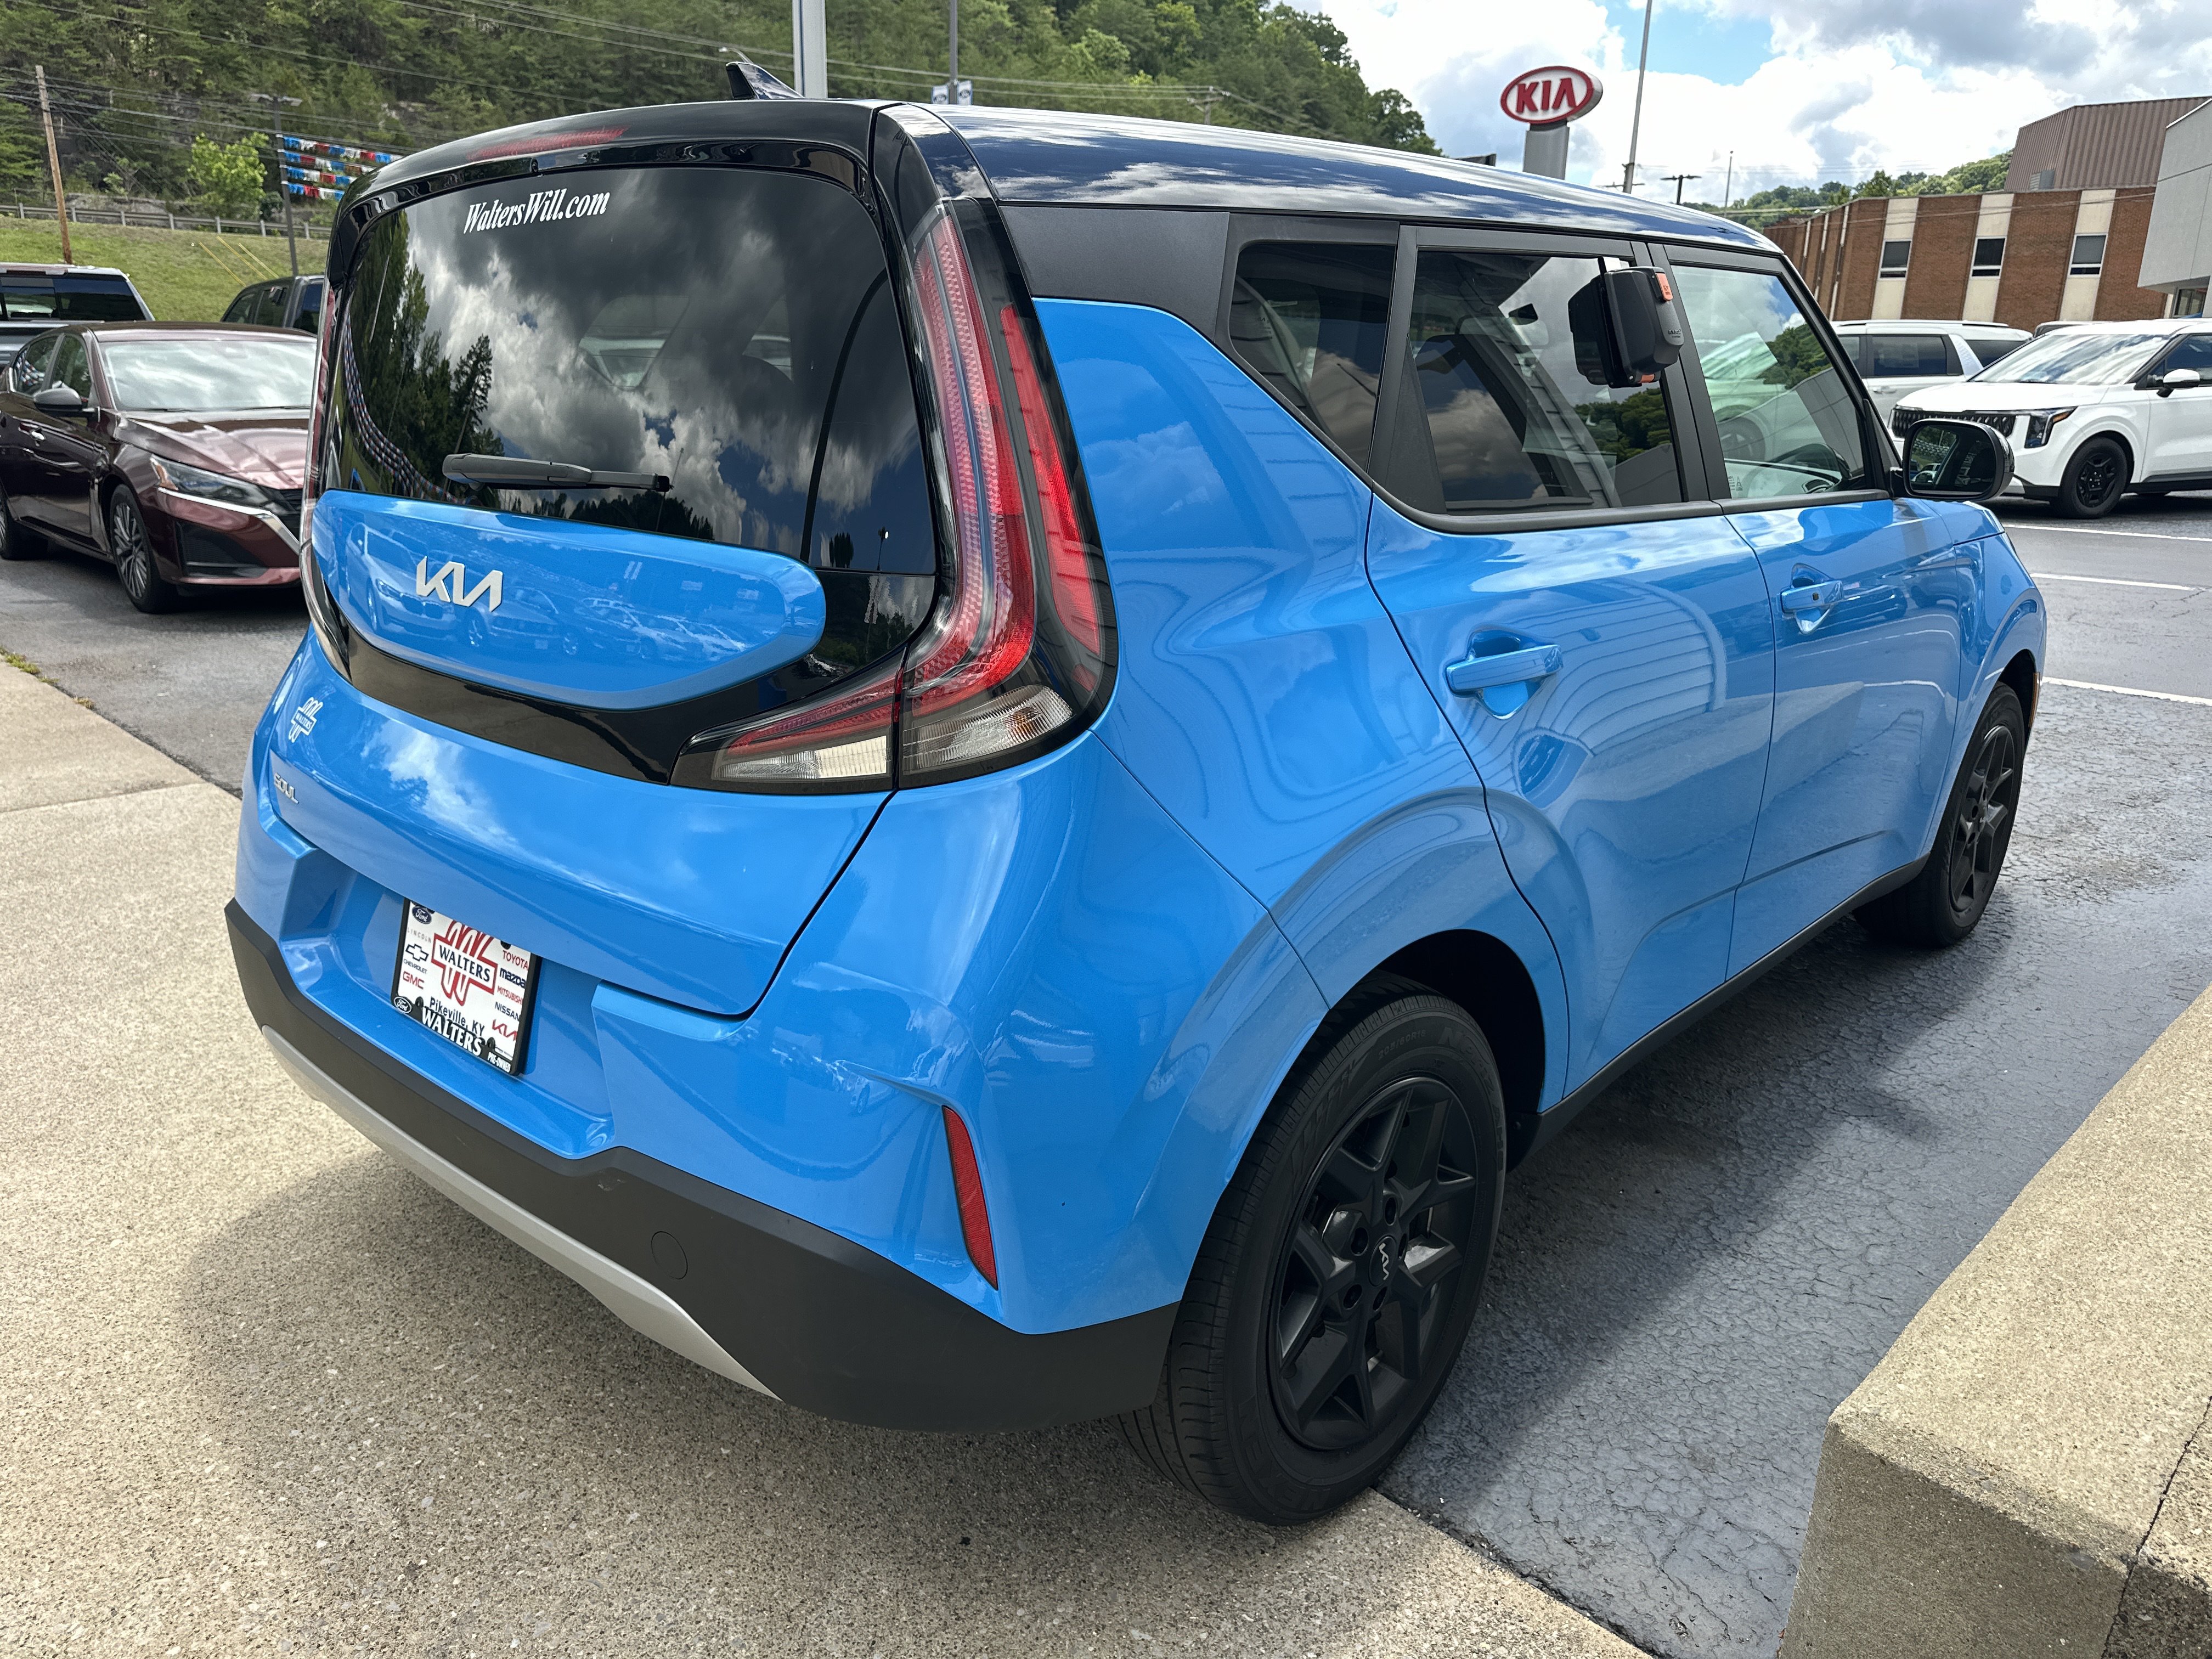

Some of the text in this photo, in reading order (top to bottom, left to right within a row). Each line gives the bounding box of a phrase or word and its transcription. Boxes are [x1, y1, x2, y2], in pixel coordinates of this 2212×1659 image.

[1516, 77, 1577, 113] KIA
[464, 188, 610, 234] WaltersWill.com
[416, 555, 503, 612] KIA
[274, 772, 299, 804] SOUL
[407, 927, 432, 944] LINCOLN
[403, 958, 427, 974] CHEVROLET
[439, 944, 490, 983] WALTERS
[503, 950, 528, 971] TOYOTA
[403, 970, 425, 990] GMC
[429, 996, 485, 1036] Pikeville, KY
[494, 1001, 520, 1022] NISSAN
[422, 1006, 483, 1057] WALTERS
